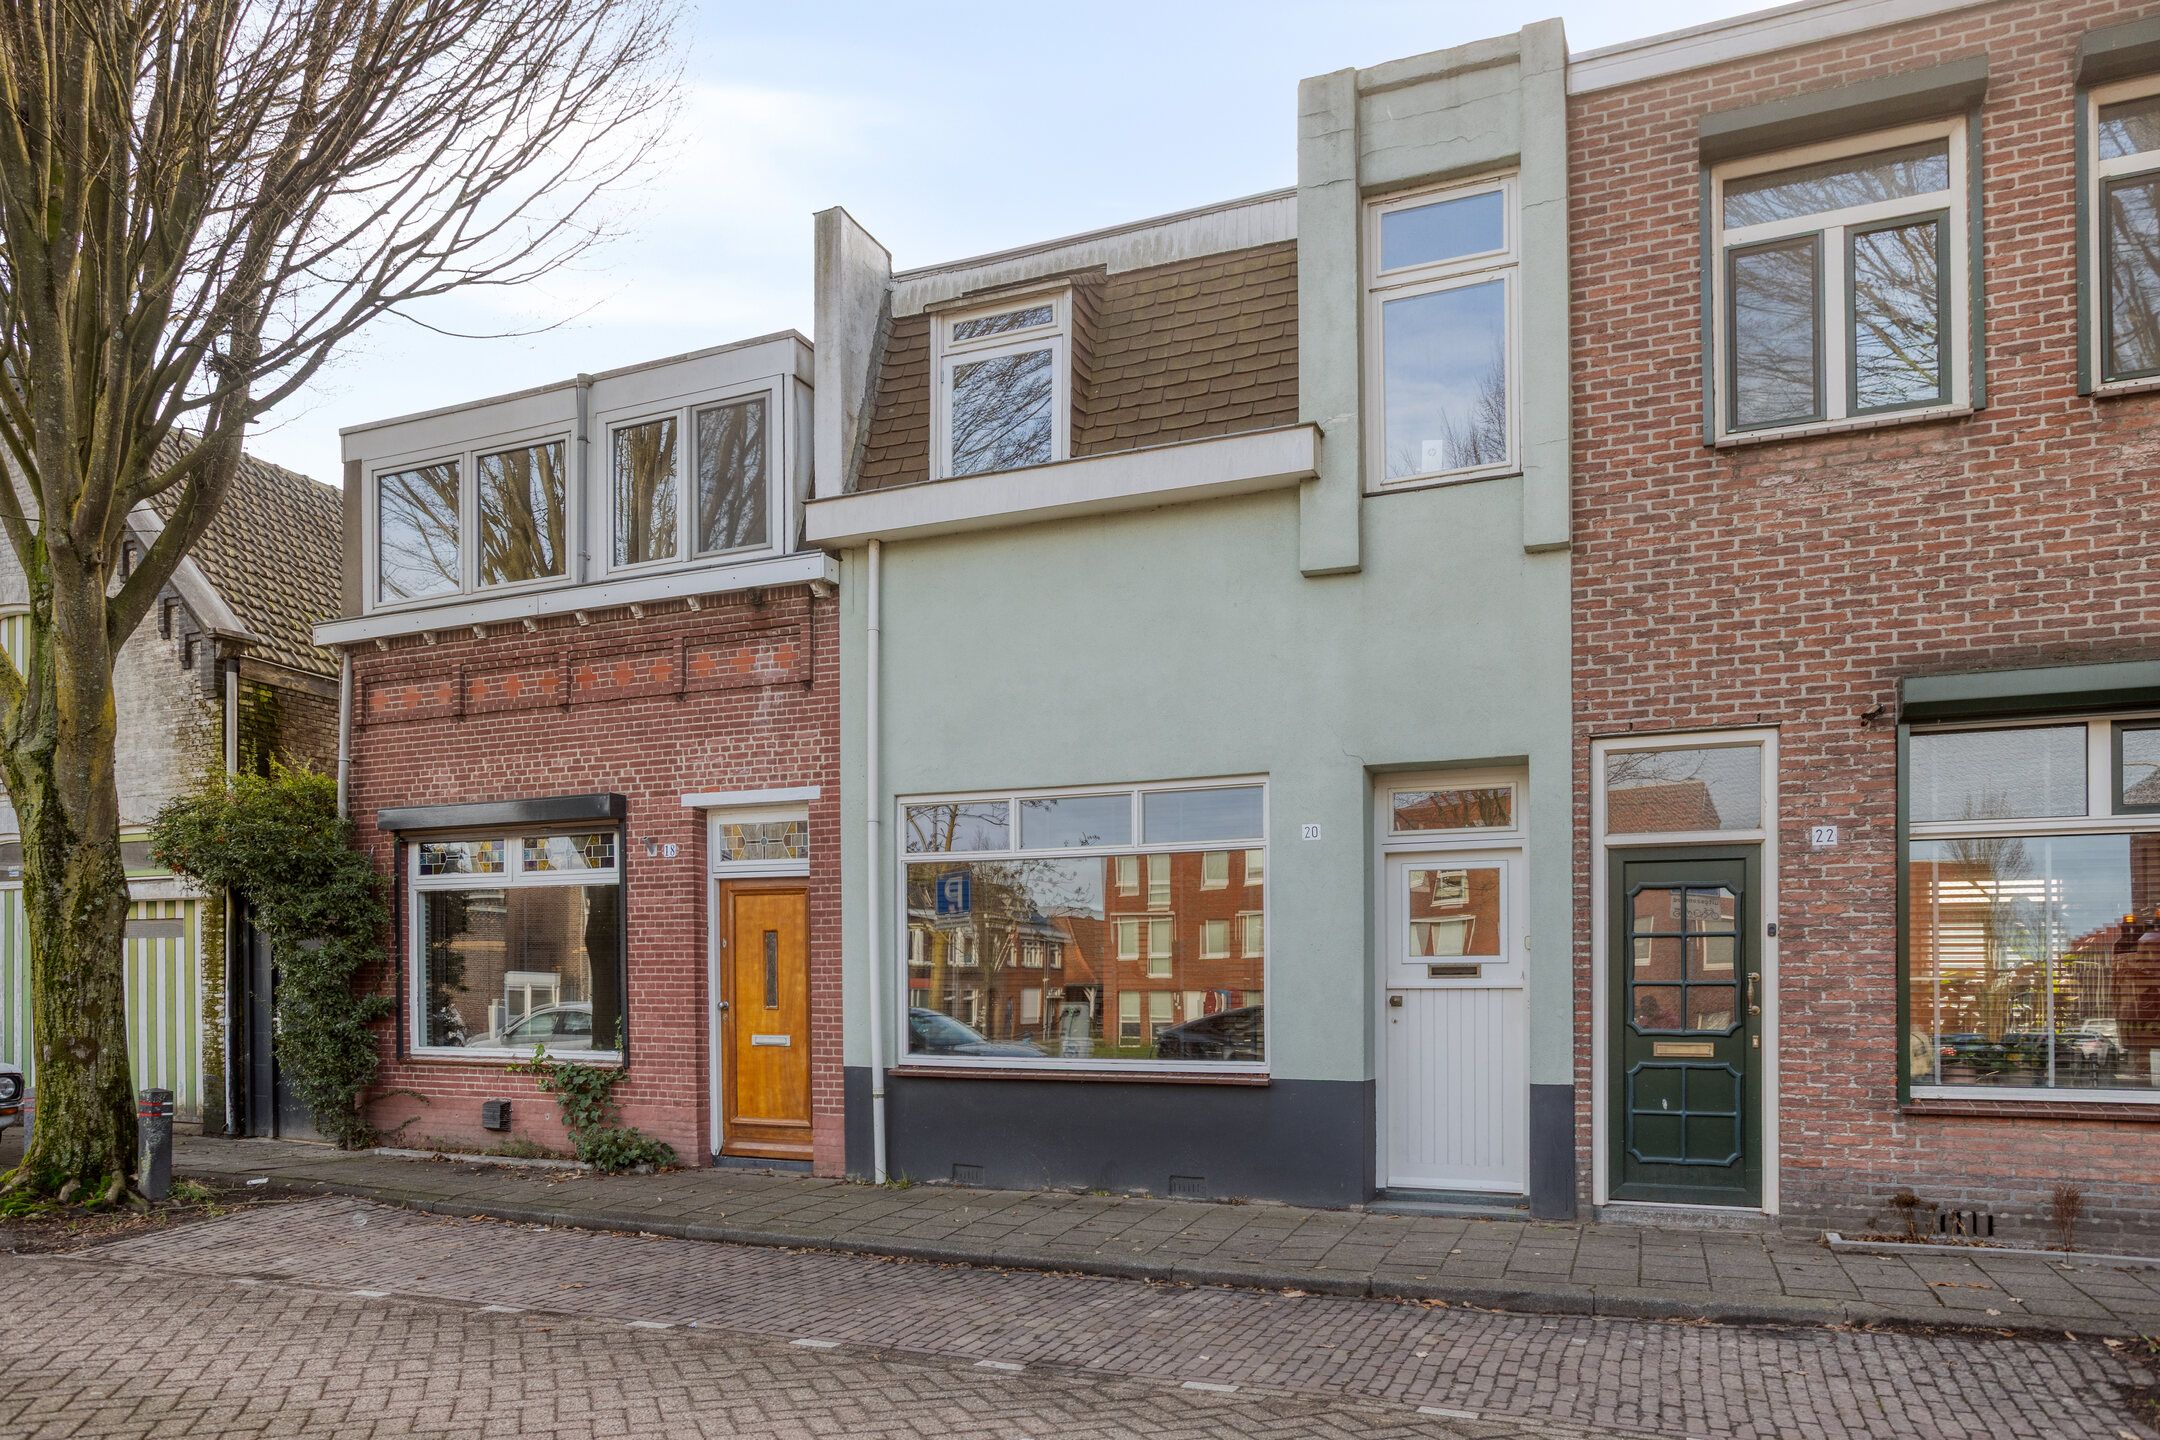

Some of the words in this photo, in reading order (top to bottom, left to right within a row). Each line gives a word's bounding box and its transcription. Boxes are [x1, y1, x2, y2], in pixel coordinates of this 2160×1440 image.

[1304, 825, 1318, 839] 20
[1815, 828, 1834, 843] 22
[664, 845, 675, 857] 18
